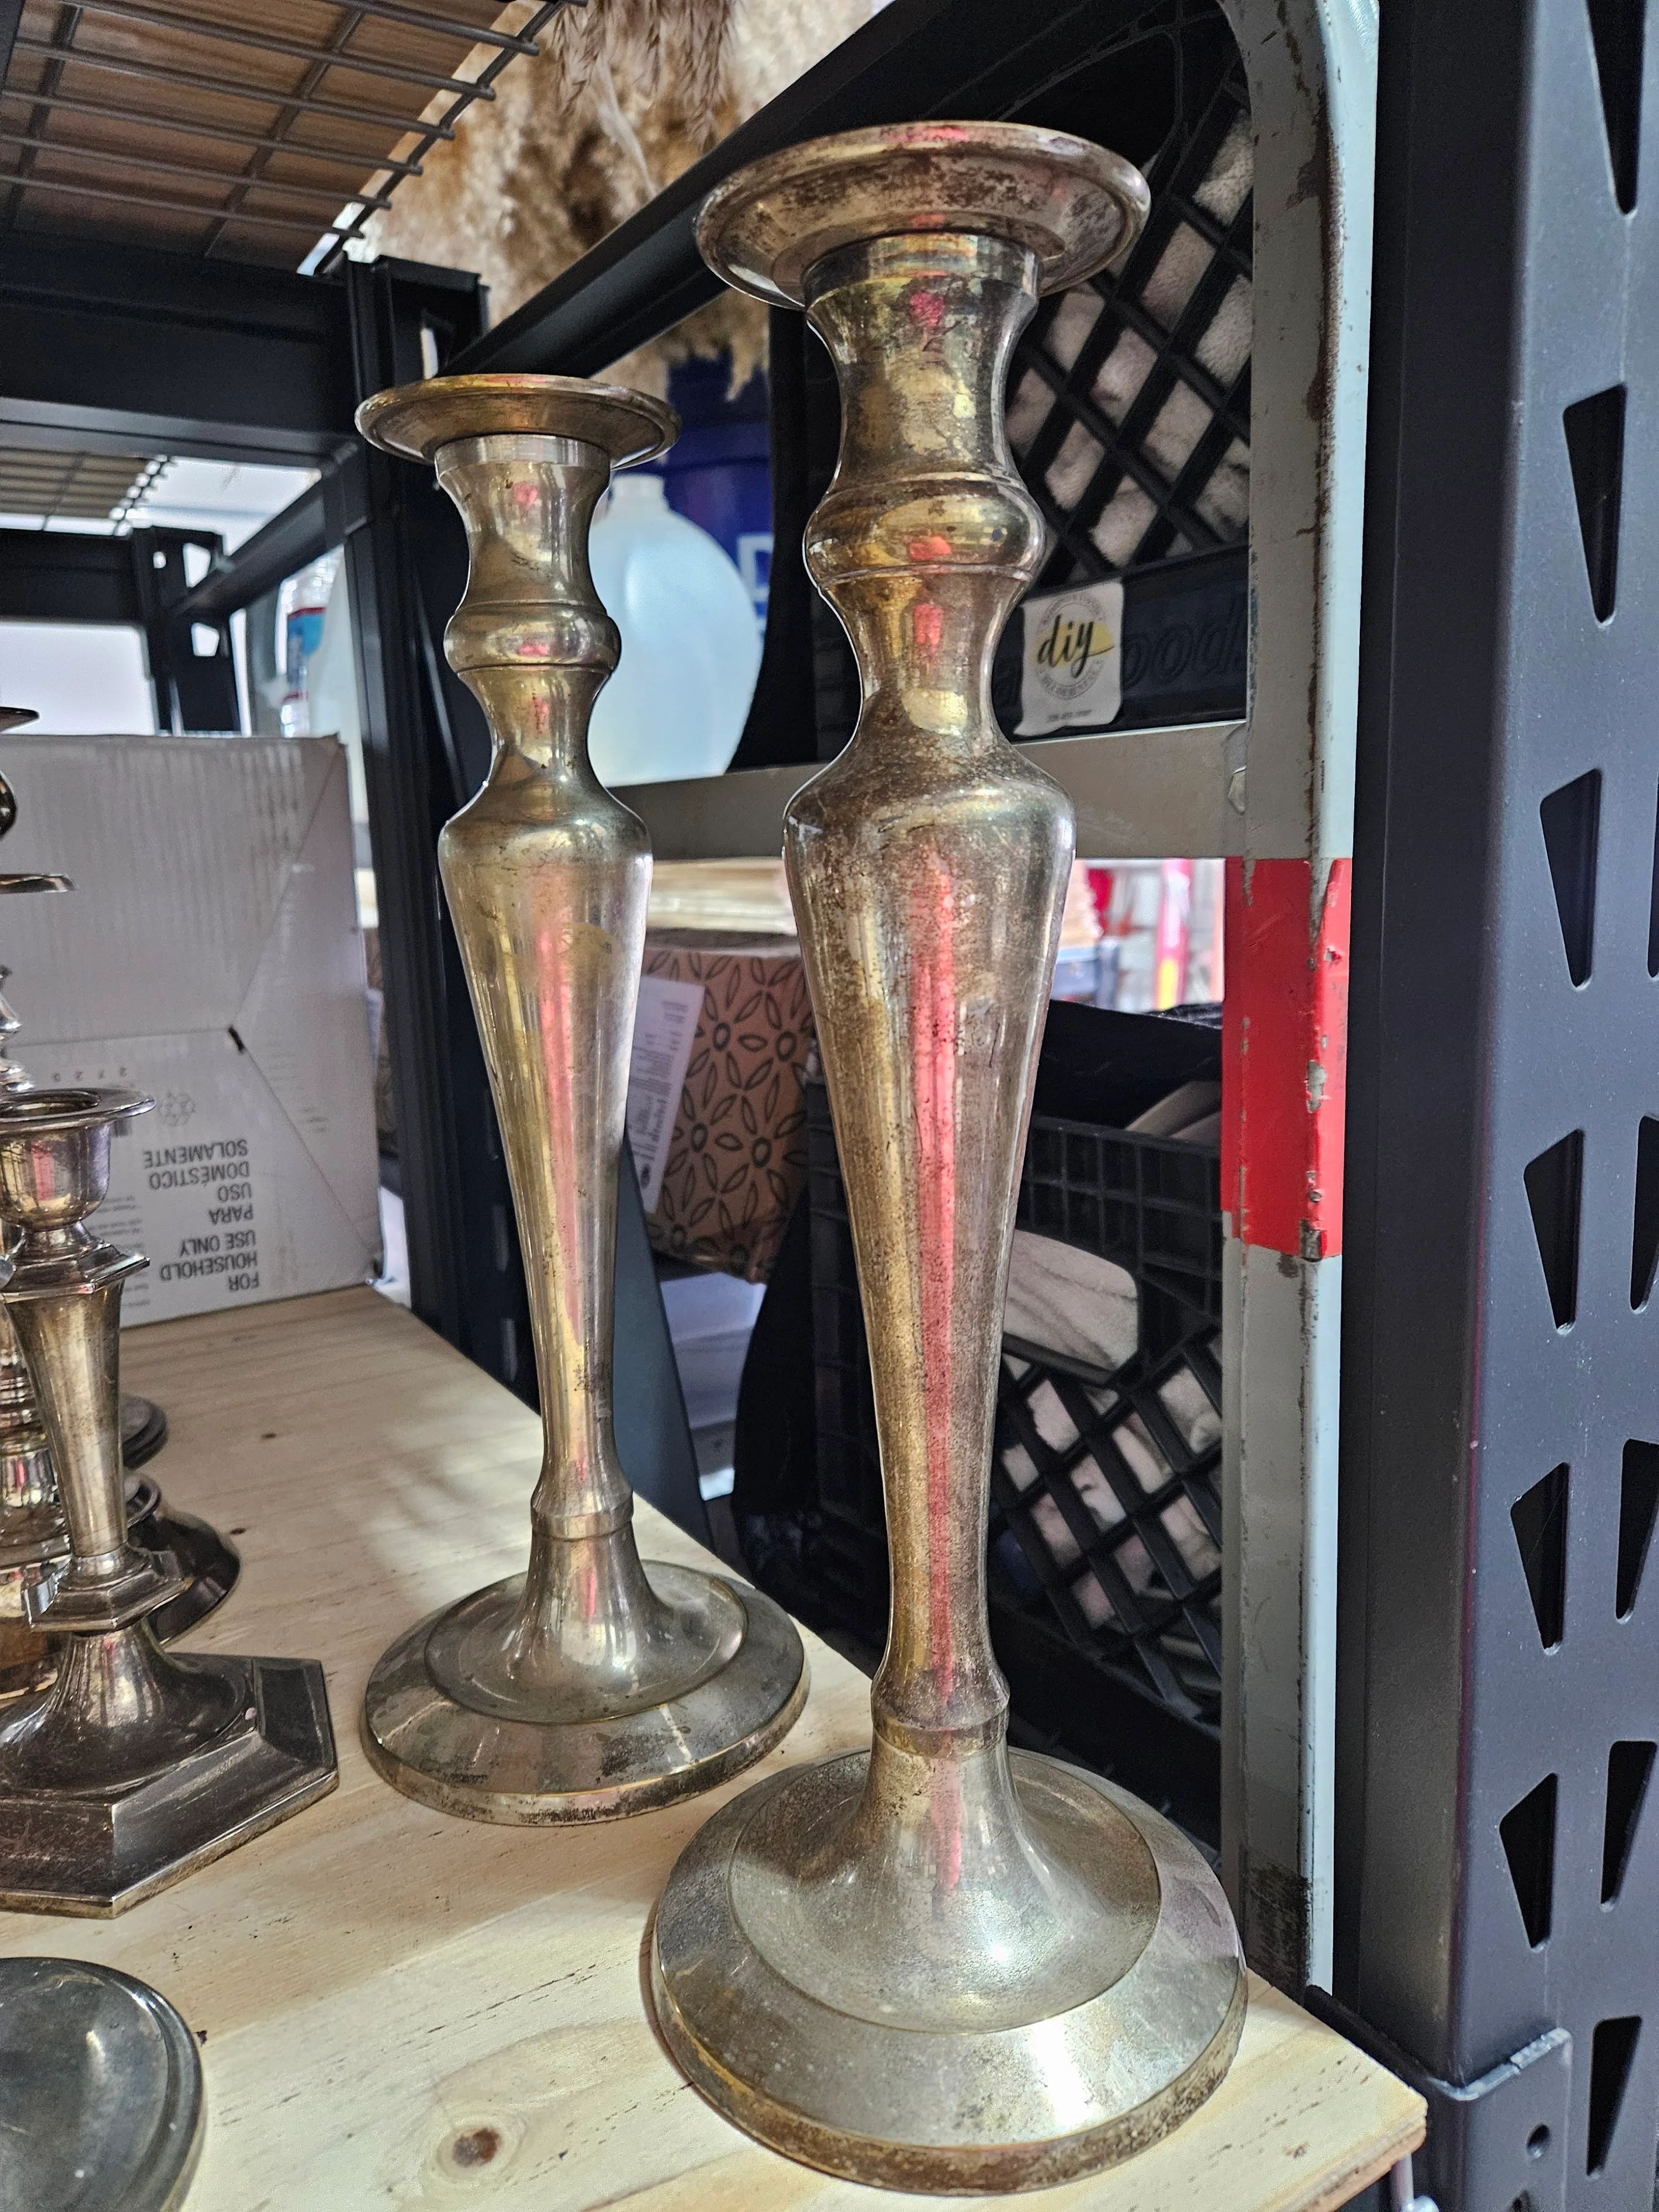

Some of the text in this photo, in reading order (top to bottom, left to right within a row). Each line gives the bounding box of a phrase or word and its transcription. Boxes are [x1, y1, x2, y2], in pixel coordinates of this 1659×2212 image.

[1037, 614, 1115, 679] diy
[143, 1138, 248, 1169] SOLAMENTE
[149, 1161, 250, 1191] DOMÉSTICO
[217, 1182, 252, 1202] USO
[208, 1204, 254, 1225] PARA
[179, 1229, 257, 1259] USE ONLY
[159, 1251, 258, 1282] HOUSEHOLD
[227, 1271, 260, 1292] FOR
